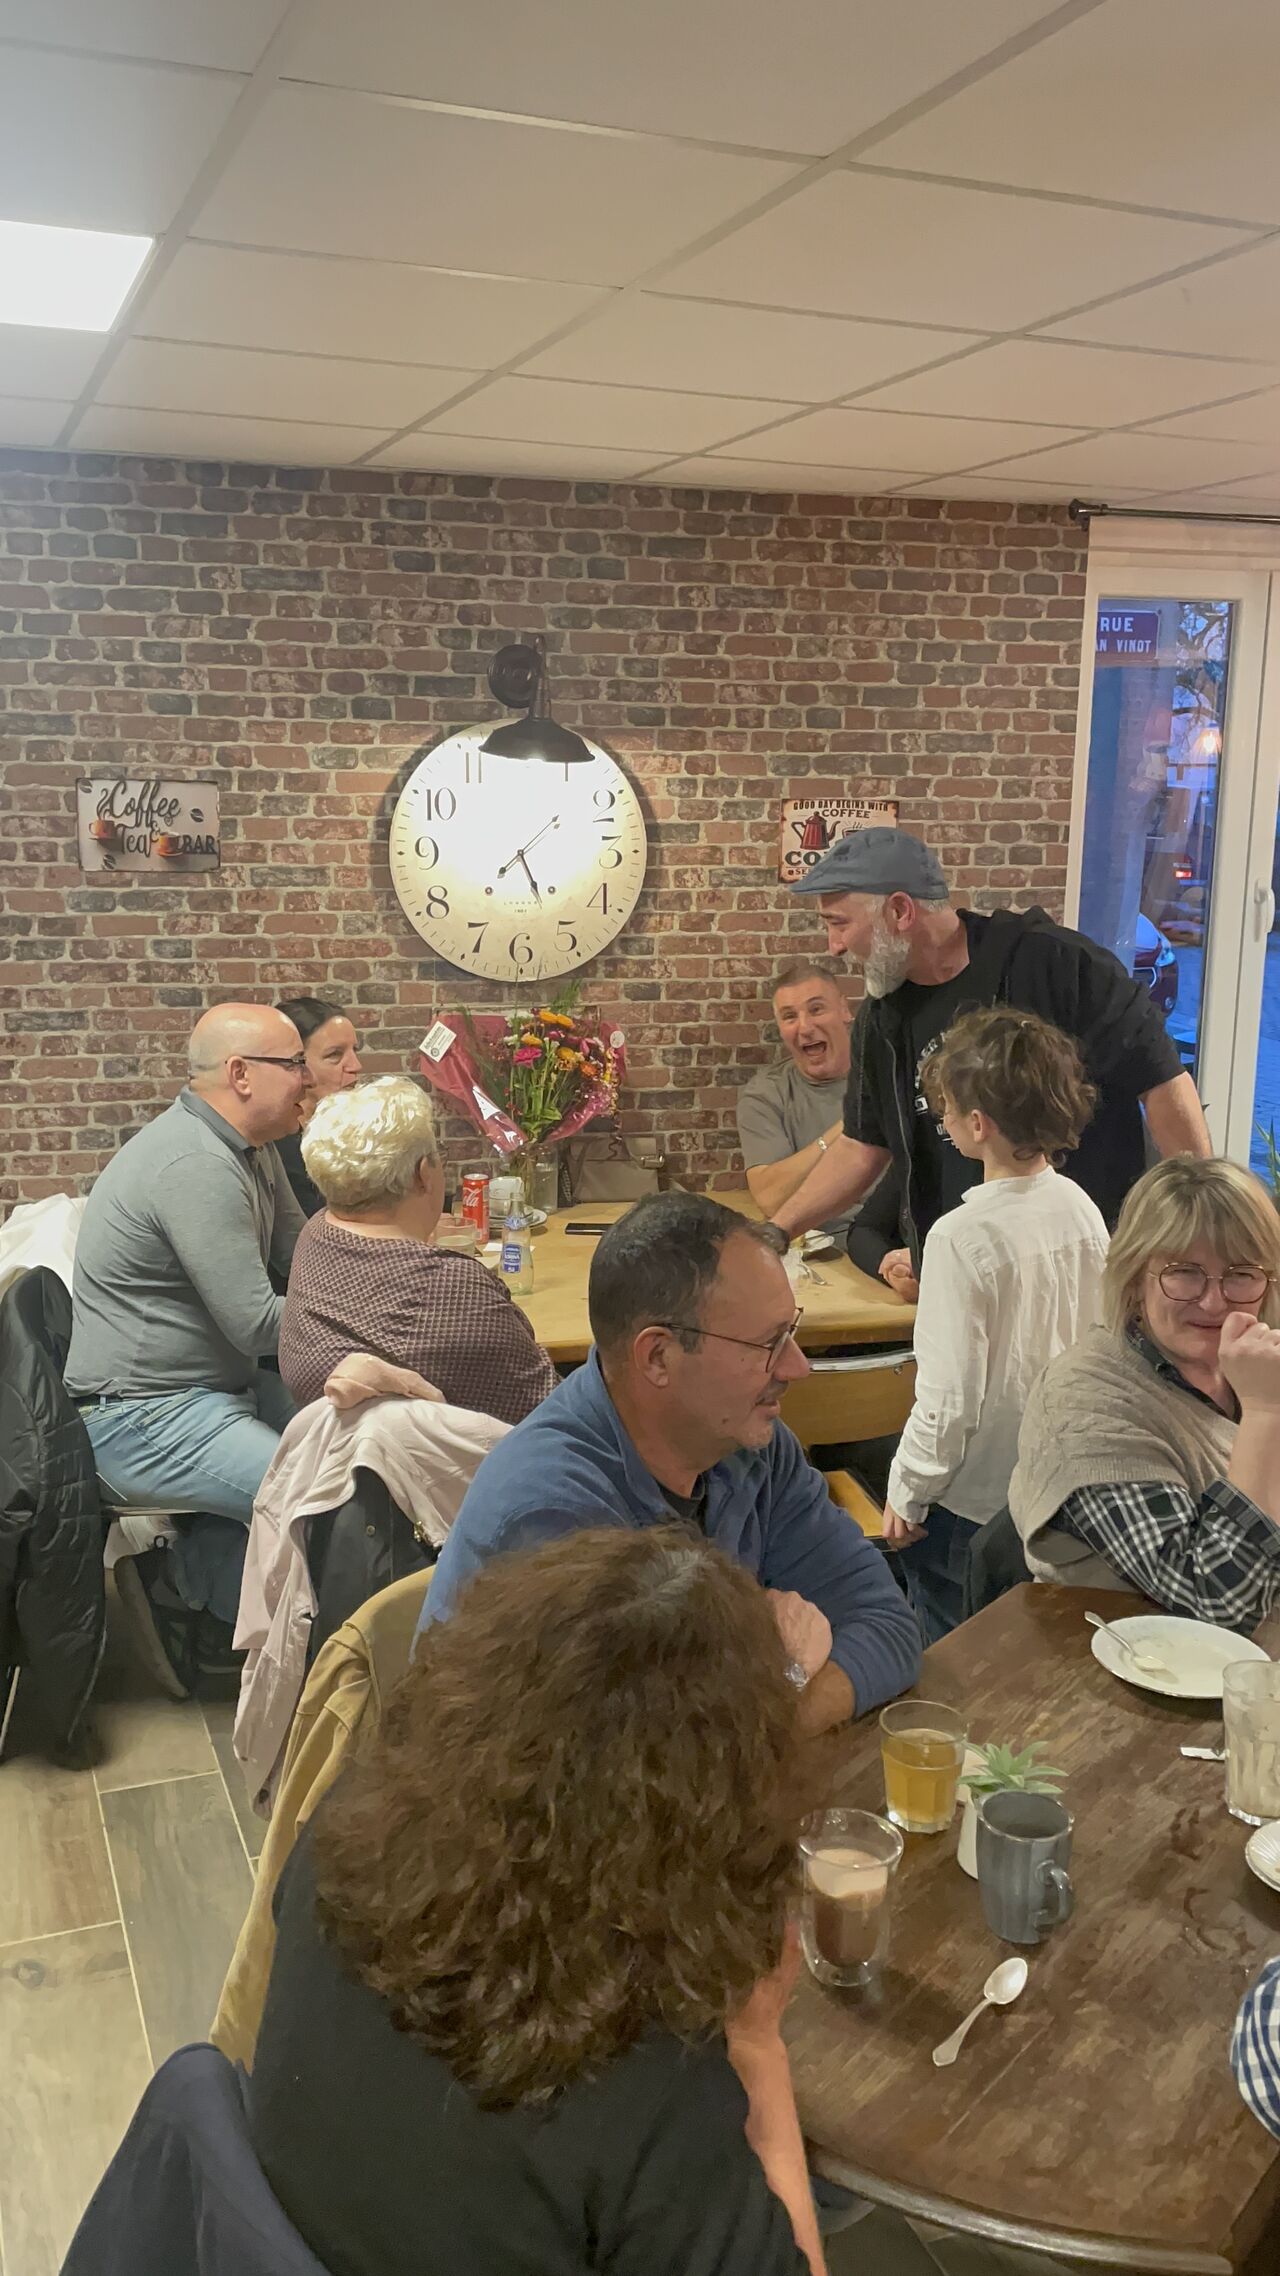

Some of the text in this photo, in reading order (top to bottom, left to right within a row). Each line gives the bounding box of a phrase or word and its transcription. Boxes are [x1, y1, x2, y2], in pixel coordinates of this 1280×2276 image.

[1100, 616, 1134, 632] RUE
[1116, 639, 1152, 654] VINOT
[108, 778, 181, 827] Coffee
[426, 787, 457, 821] 10
[592, 789, 616, 823] 2
[793, 800, 889, 811] GOOD DAY BEGINS WITH
[821, 809, 871, 818] COFFEE
[116, 824, 150, 857] Tea
[182, 834, 216, 854] BAR
[414, 836, 439, 870] 9
[598, 835, 623, 869] 3
[426, 885, 450, 919] 8
[586, 883, 612, 915] 4
[467, 921, 490, 953] 7
[508, 932, 533, 964] 6
[554, 920, 578, 952] 5
